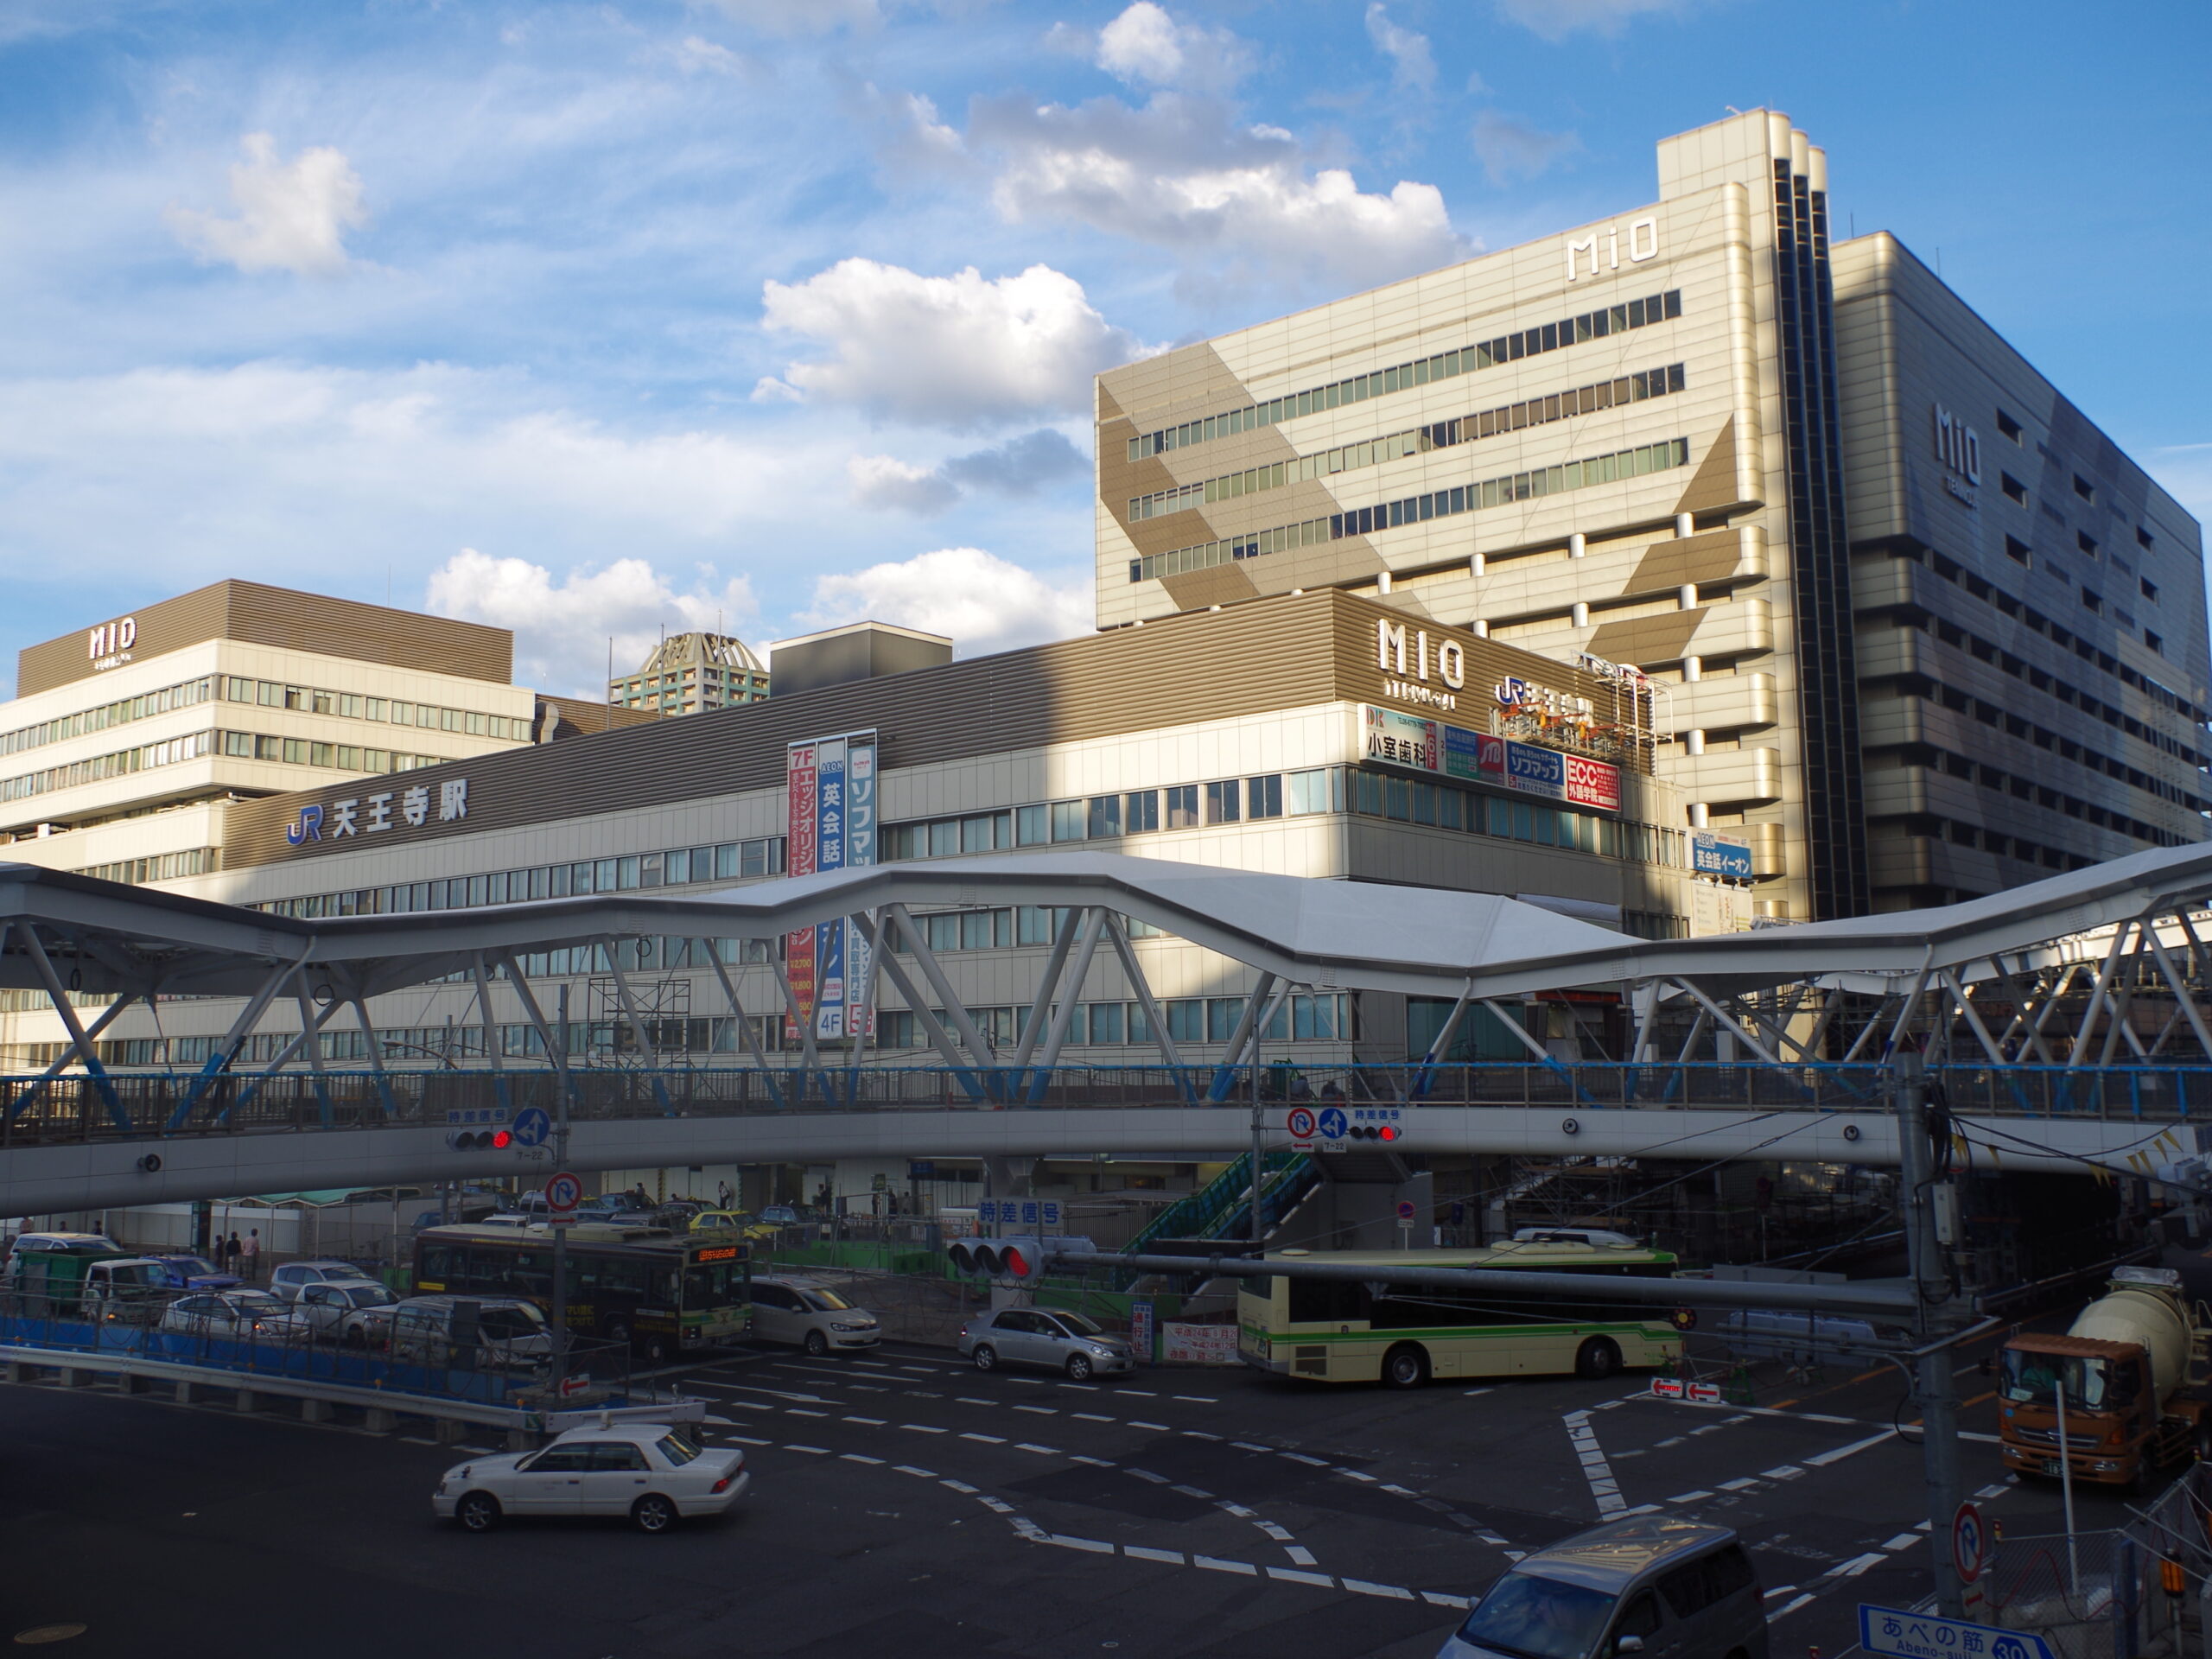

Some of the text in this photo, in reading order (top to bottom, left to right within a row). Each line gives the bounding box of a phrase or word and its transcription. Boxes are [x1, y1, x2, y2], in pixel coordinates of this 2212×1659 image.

[89, 616, 137, 659] MIO
[1378, 618, 1465, 690] MIO
[1495, 675, 1525, 705] JR
[792, 750, 814, 767] 7F
[1369, 732, 1427, 767] 小室歯科
[1480, 741, 1502, 765] JTB
[822, 761, 843, 773] AEON
[1511, 755, 1560, 780] ソフマップ
[1567, 760, 1598, 786] ECC
[1569, 782, 1599, 803] 外語学院
[286, 779, 467, 846] JR 天王寺駅
[823, 783, 841, 864] 英会話
[821, 1014, 841, 1033] 4F
[1355, 1109, 1400, 1120] 時差信号
[1324, 1141, 1344, 1150] 7-22
[980, 1201, 1059, 1224] 時差信号
[1883, 1616, 1984, 1654] あべの筋
[1997, 1643, 2025, 1659] 30
